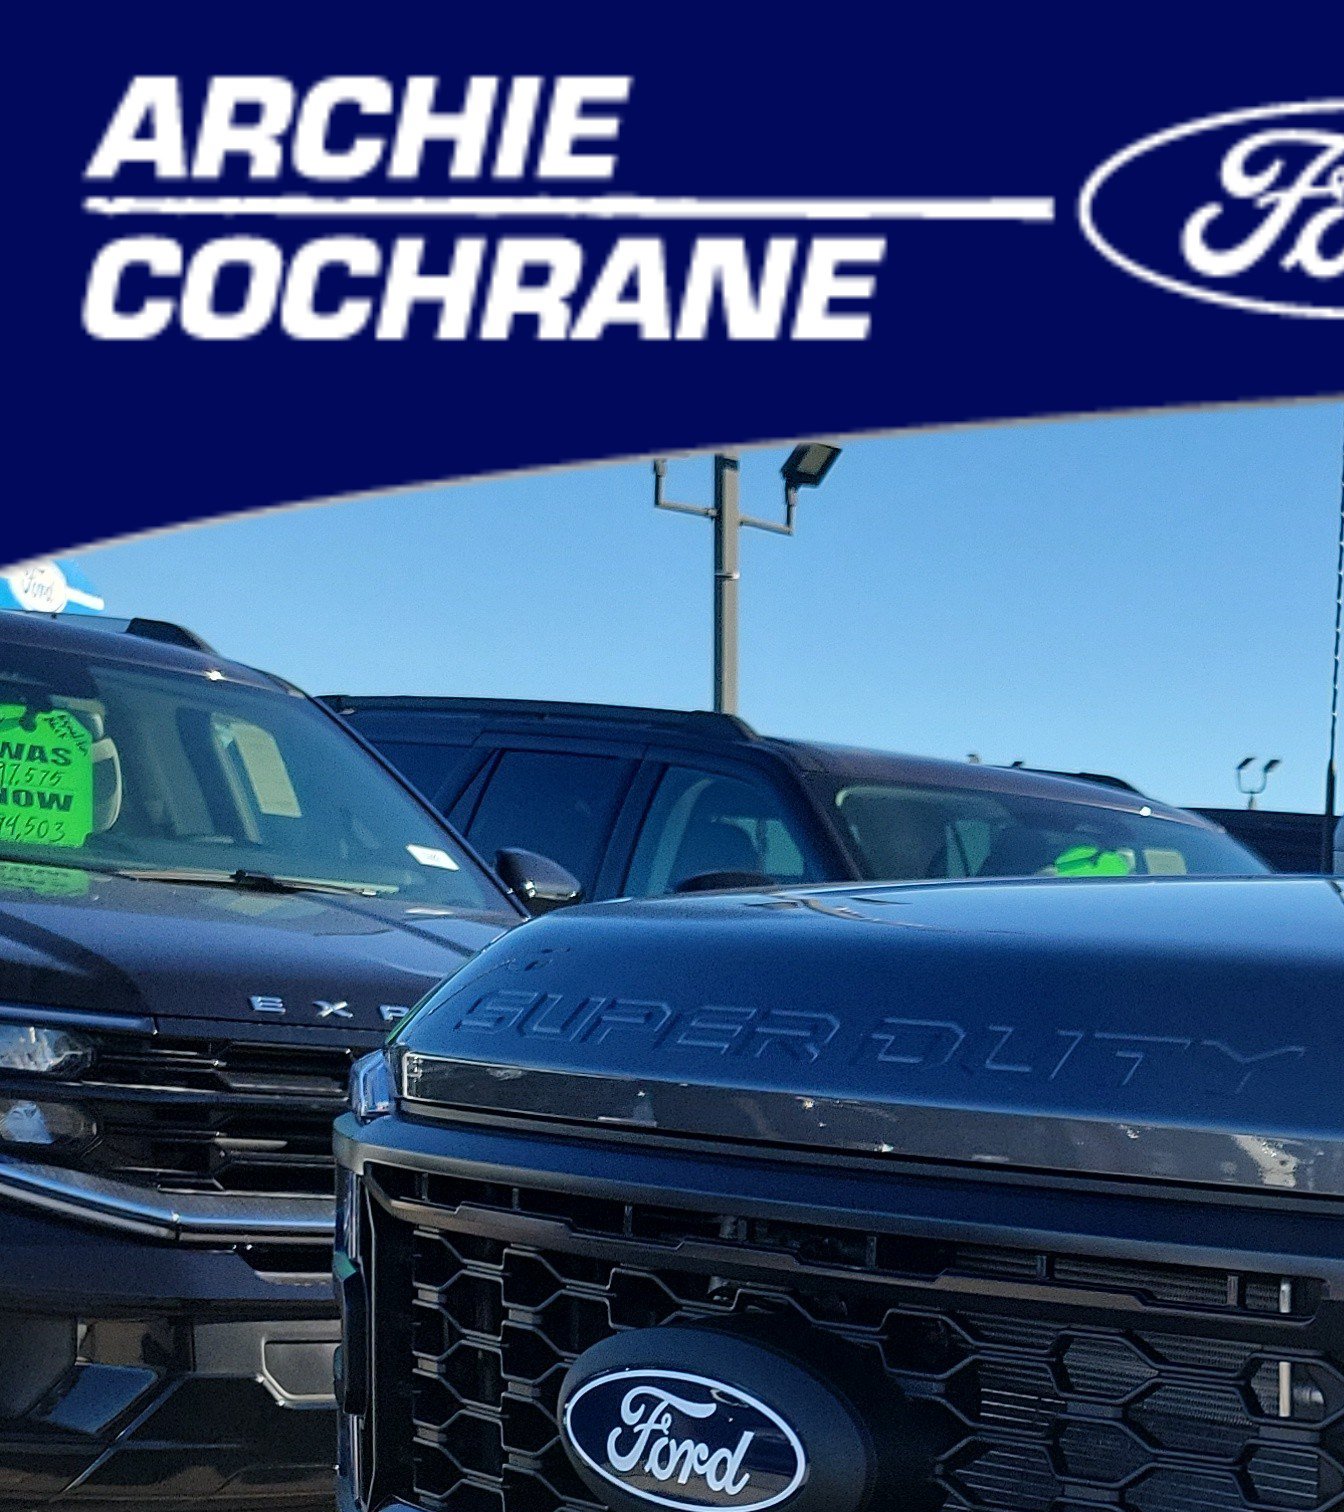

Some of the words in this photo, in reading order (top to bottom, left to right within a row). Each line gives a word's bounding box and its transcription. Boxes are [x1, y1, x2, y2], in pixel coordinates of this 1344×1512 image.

[453, 990, 842, 1064] SUPER
[856, 1016, 1305, 1096] DUTY
[606, 1385, 756, 1496] Ford
